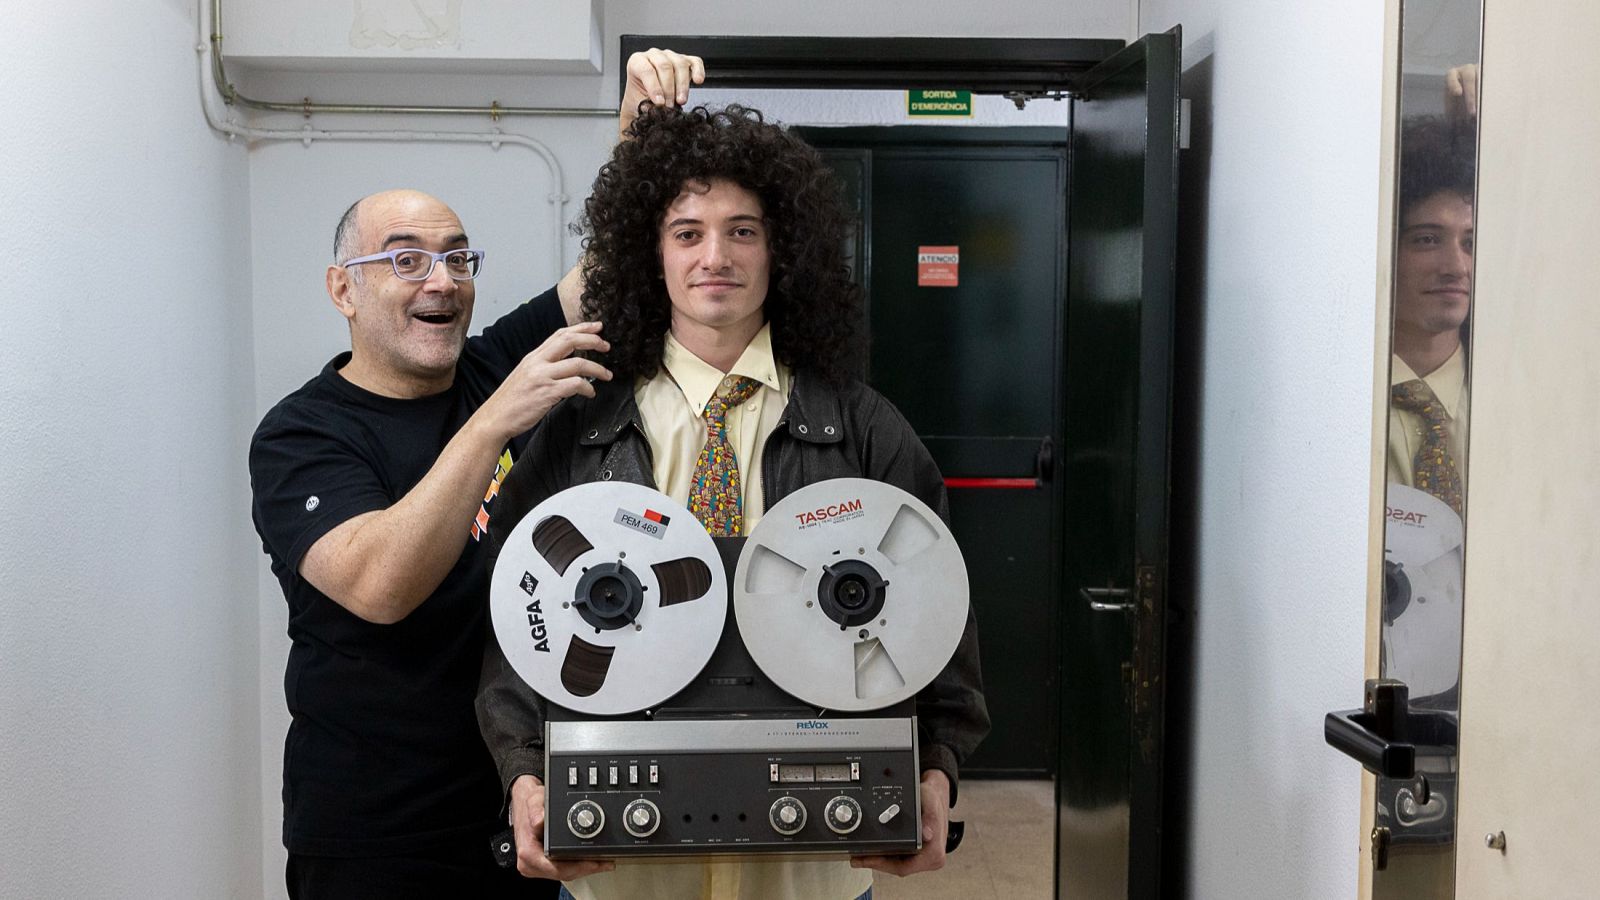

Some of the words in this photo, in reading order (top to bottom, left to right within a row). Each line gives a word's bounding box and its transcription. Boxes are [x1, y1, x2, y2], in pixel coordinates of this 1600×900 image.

[922, 90, 958, 99] SORTIDA
[796, 499, 862, 524] TASCAM
[621, 514, 641, 528] PEM
[641, 522, 658, 534] 469
[526, 599, 551, 653] AGFA
